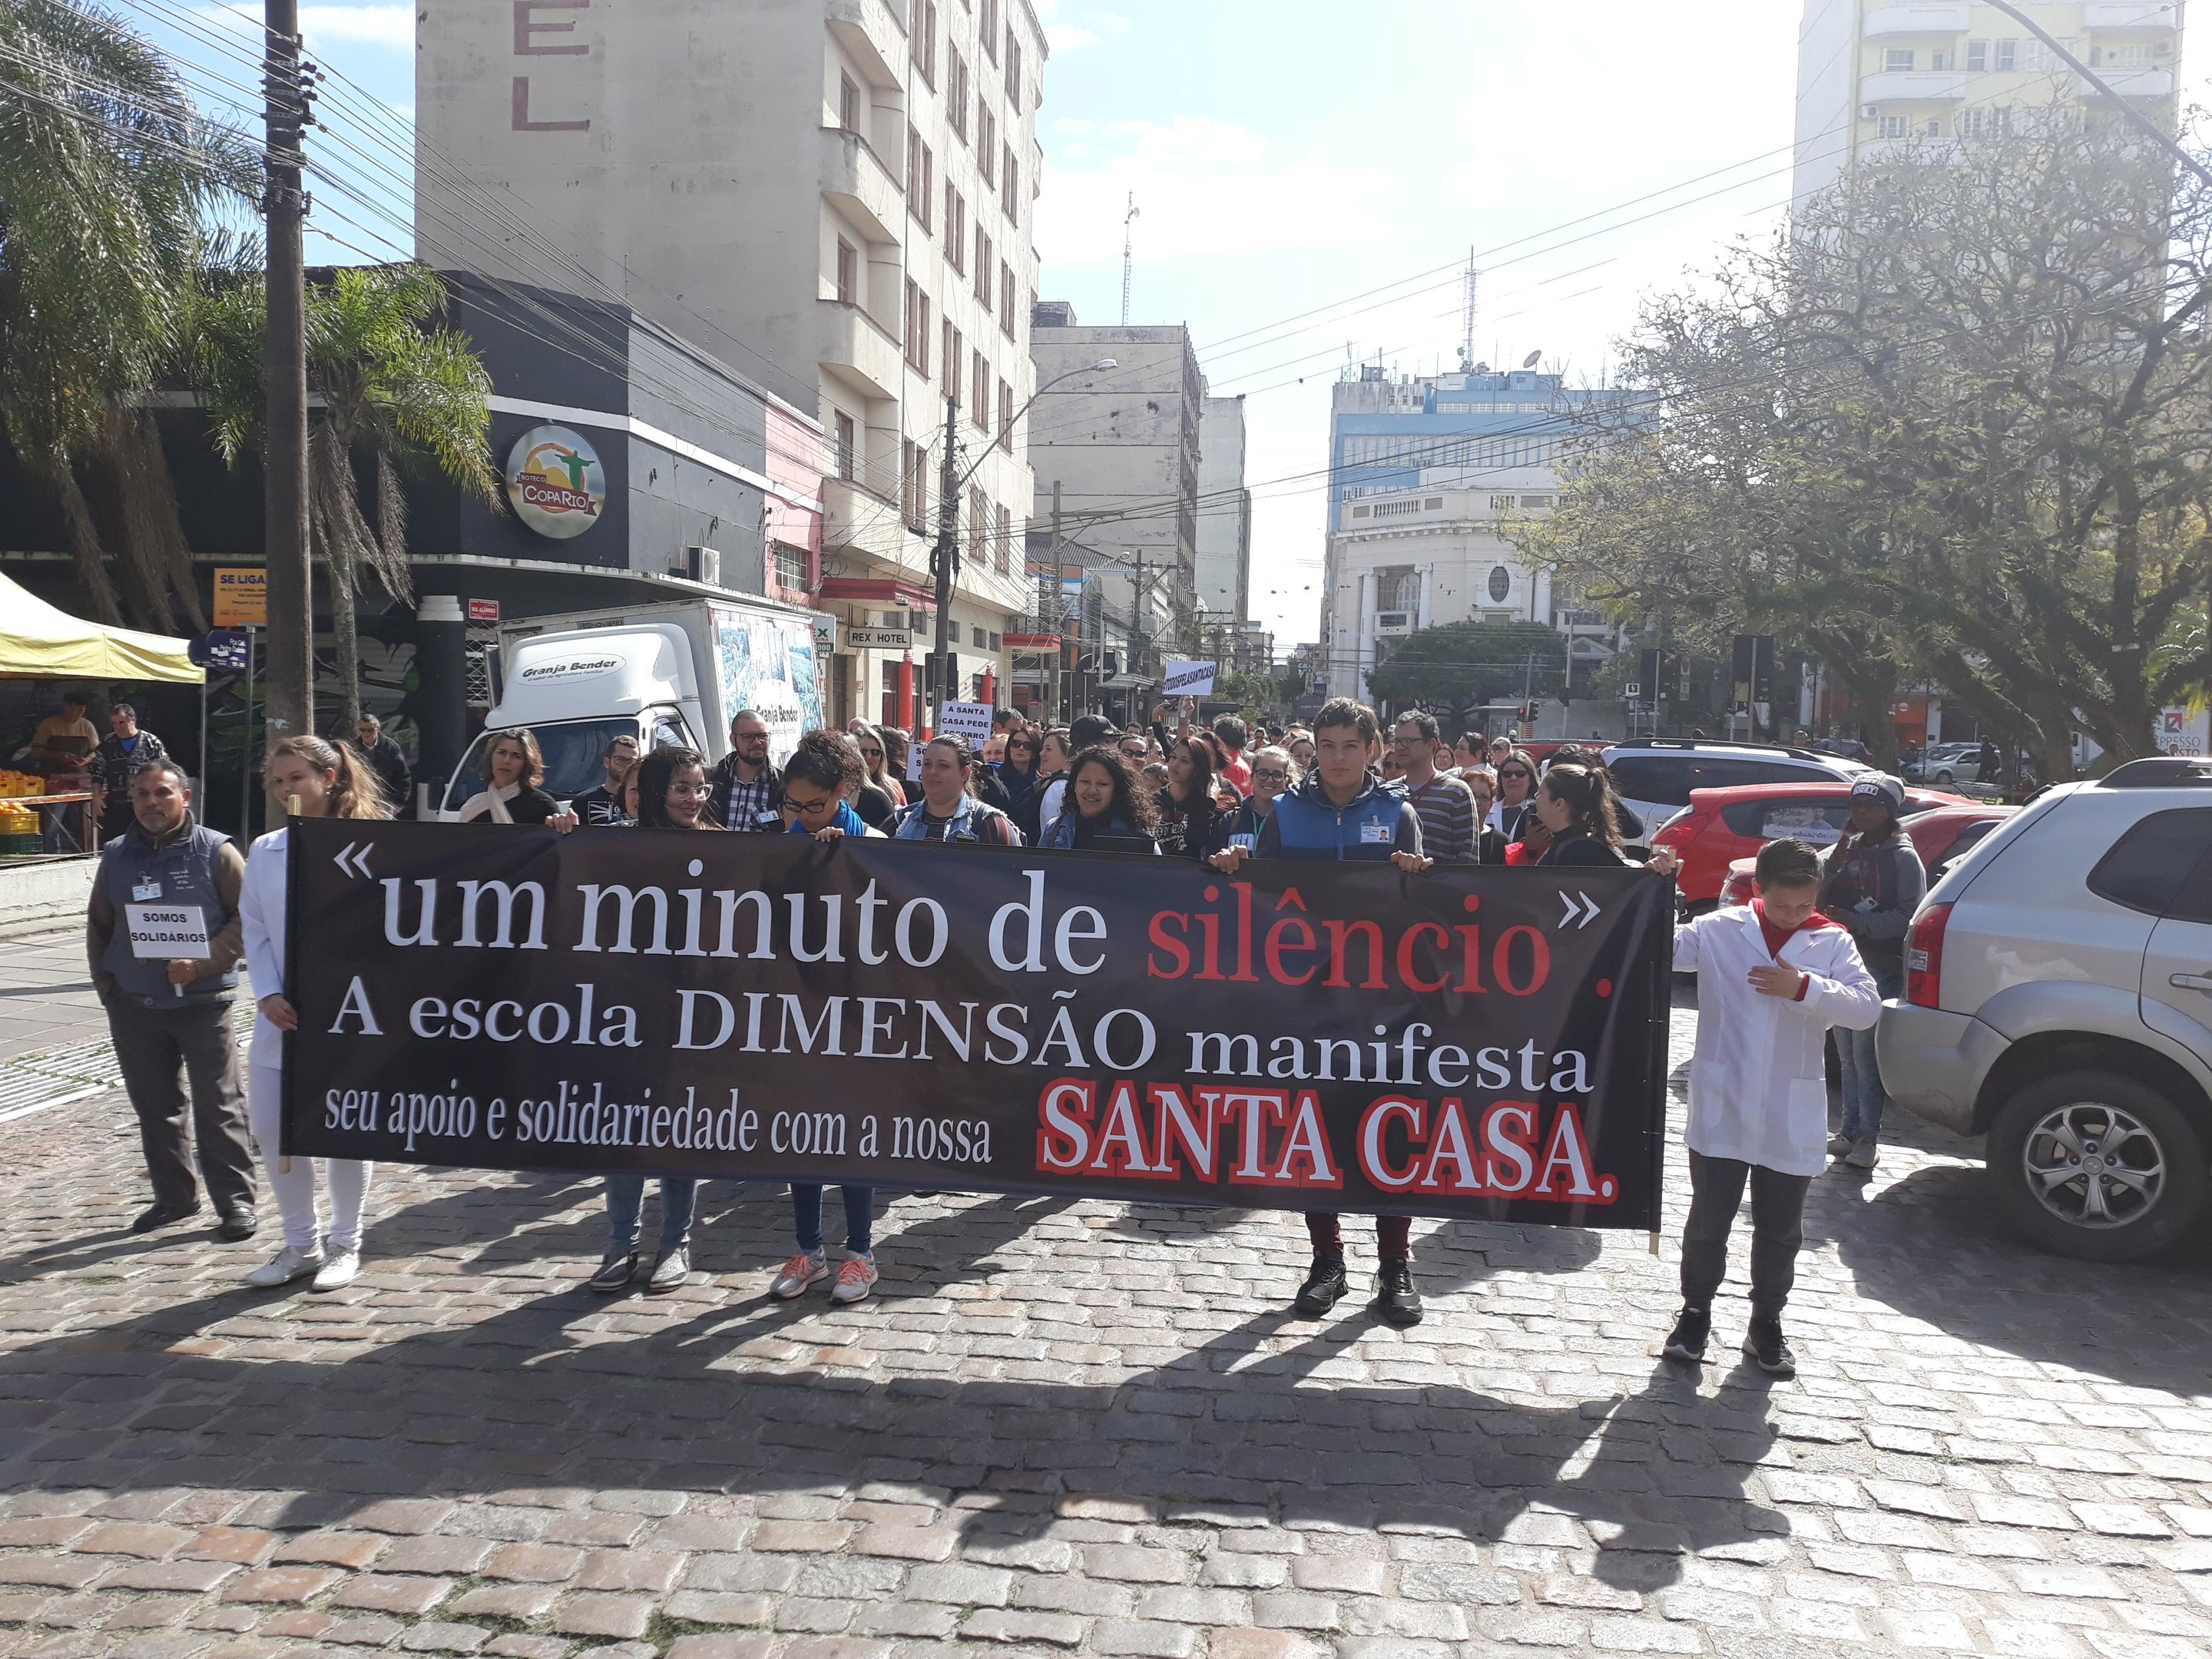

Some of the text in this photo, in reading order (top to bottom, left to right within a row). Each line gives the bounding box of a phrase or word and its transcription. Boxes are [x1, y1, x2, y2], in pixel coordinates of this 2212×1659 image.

[521, 473, 546, 483] BOTECO
[220, 575, 235, 584] SE
[852, 632, 907, 644] REX HOTEL
[522, 659, 618, 677] Granja Bender
[778, 704, 798, 723] Bender
[956, 707, 985, 716] SANTA
[942, 717, 989, 728] CASA PEDE
[142, 912, 187, 923] SOMOS
[571, 859, 949, 968] minuto
[988, 869, 1108, 975] de
[131, 930, 207, 943] SOLIDÁRIOS
[327, 975, 1594, 1094] A escola DIMENSÃO manifesta
[324, 1077, 1618, 1206] seu apoio e solidariedade com a nossa SANTA CASA.
